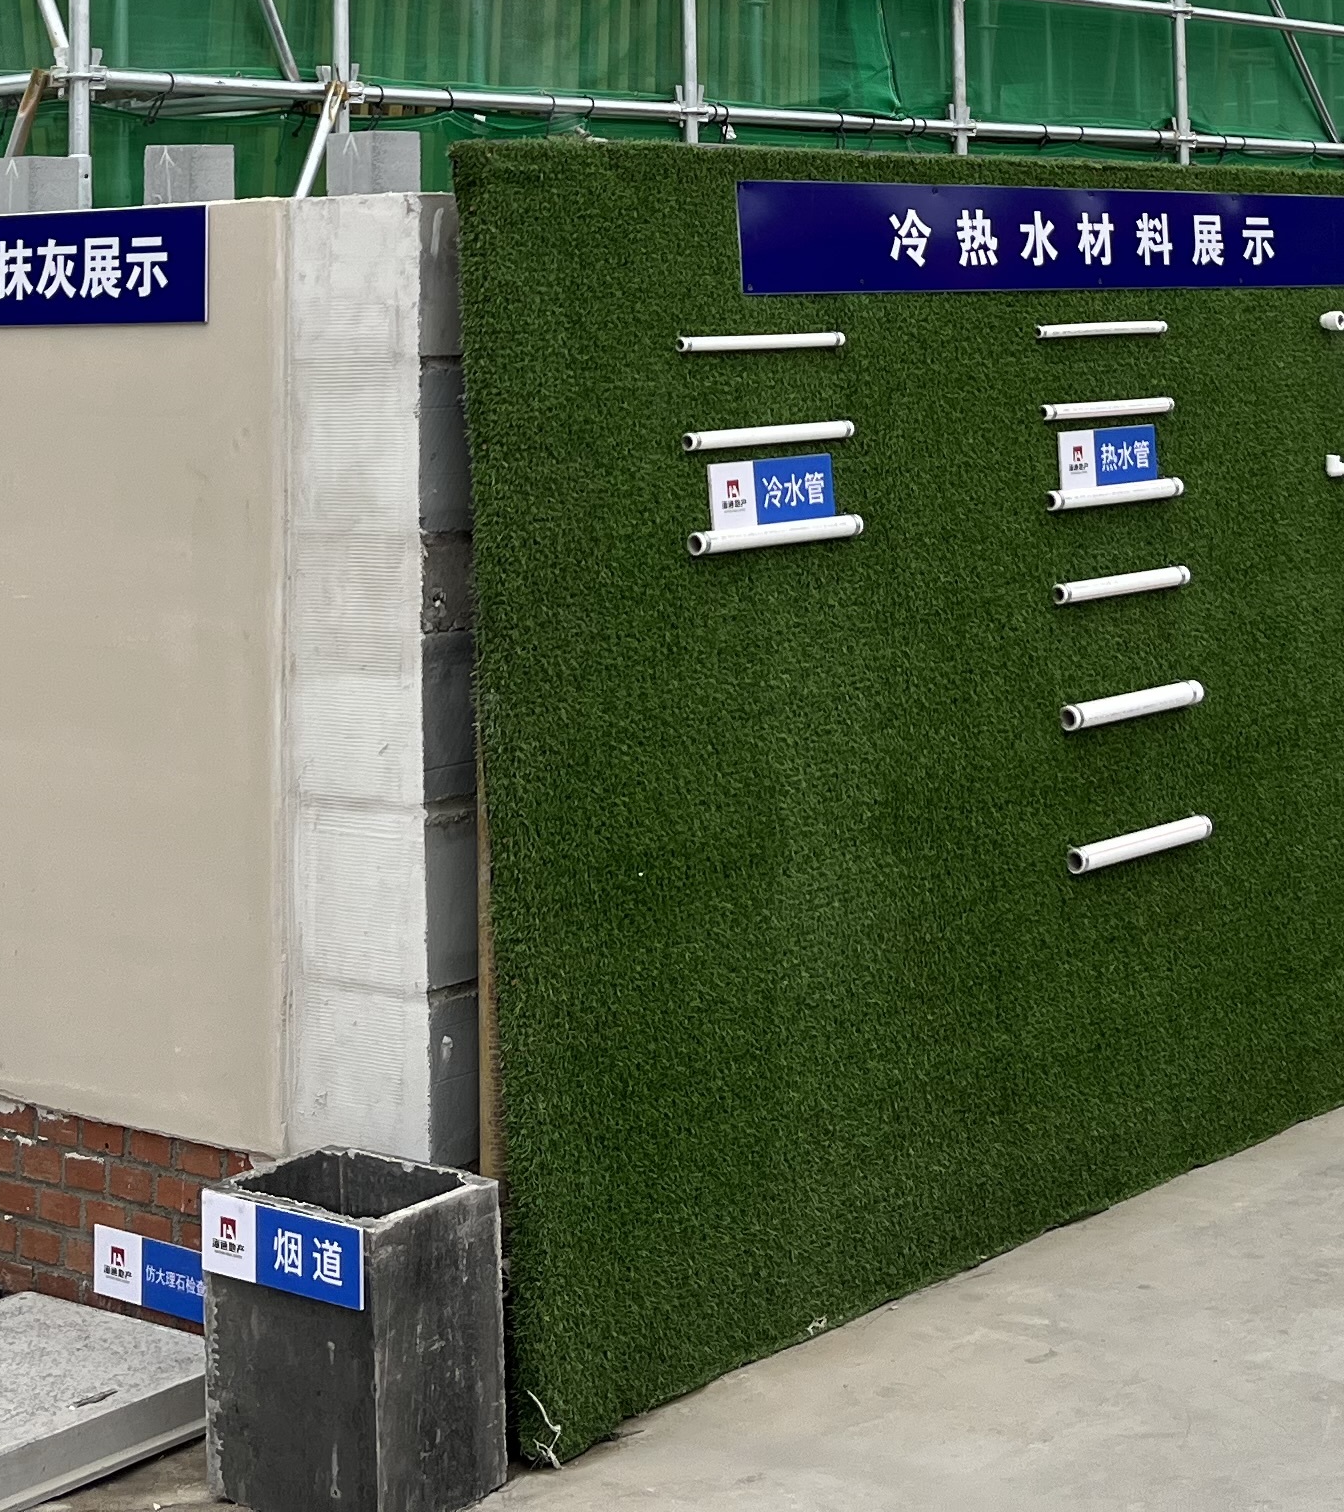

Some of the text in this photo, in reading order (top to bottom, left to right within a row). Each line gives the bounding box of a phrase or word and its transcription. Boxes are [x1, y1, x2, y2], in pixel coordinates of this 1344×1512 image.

[888, 207, 1276, 267] 冷热水材料展示
[1101, 439, 1150, 472] 热水管
[761, 471, 825, 510] 冷水管
[273, 1228, 344, 1287] 烟道
